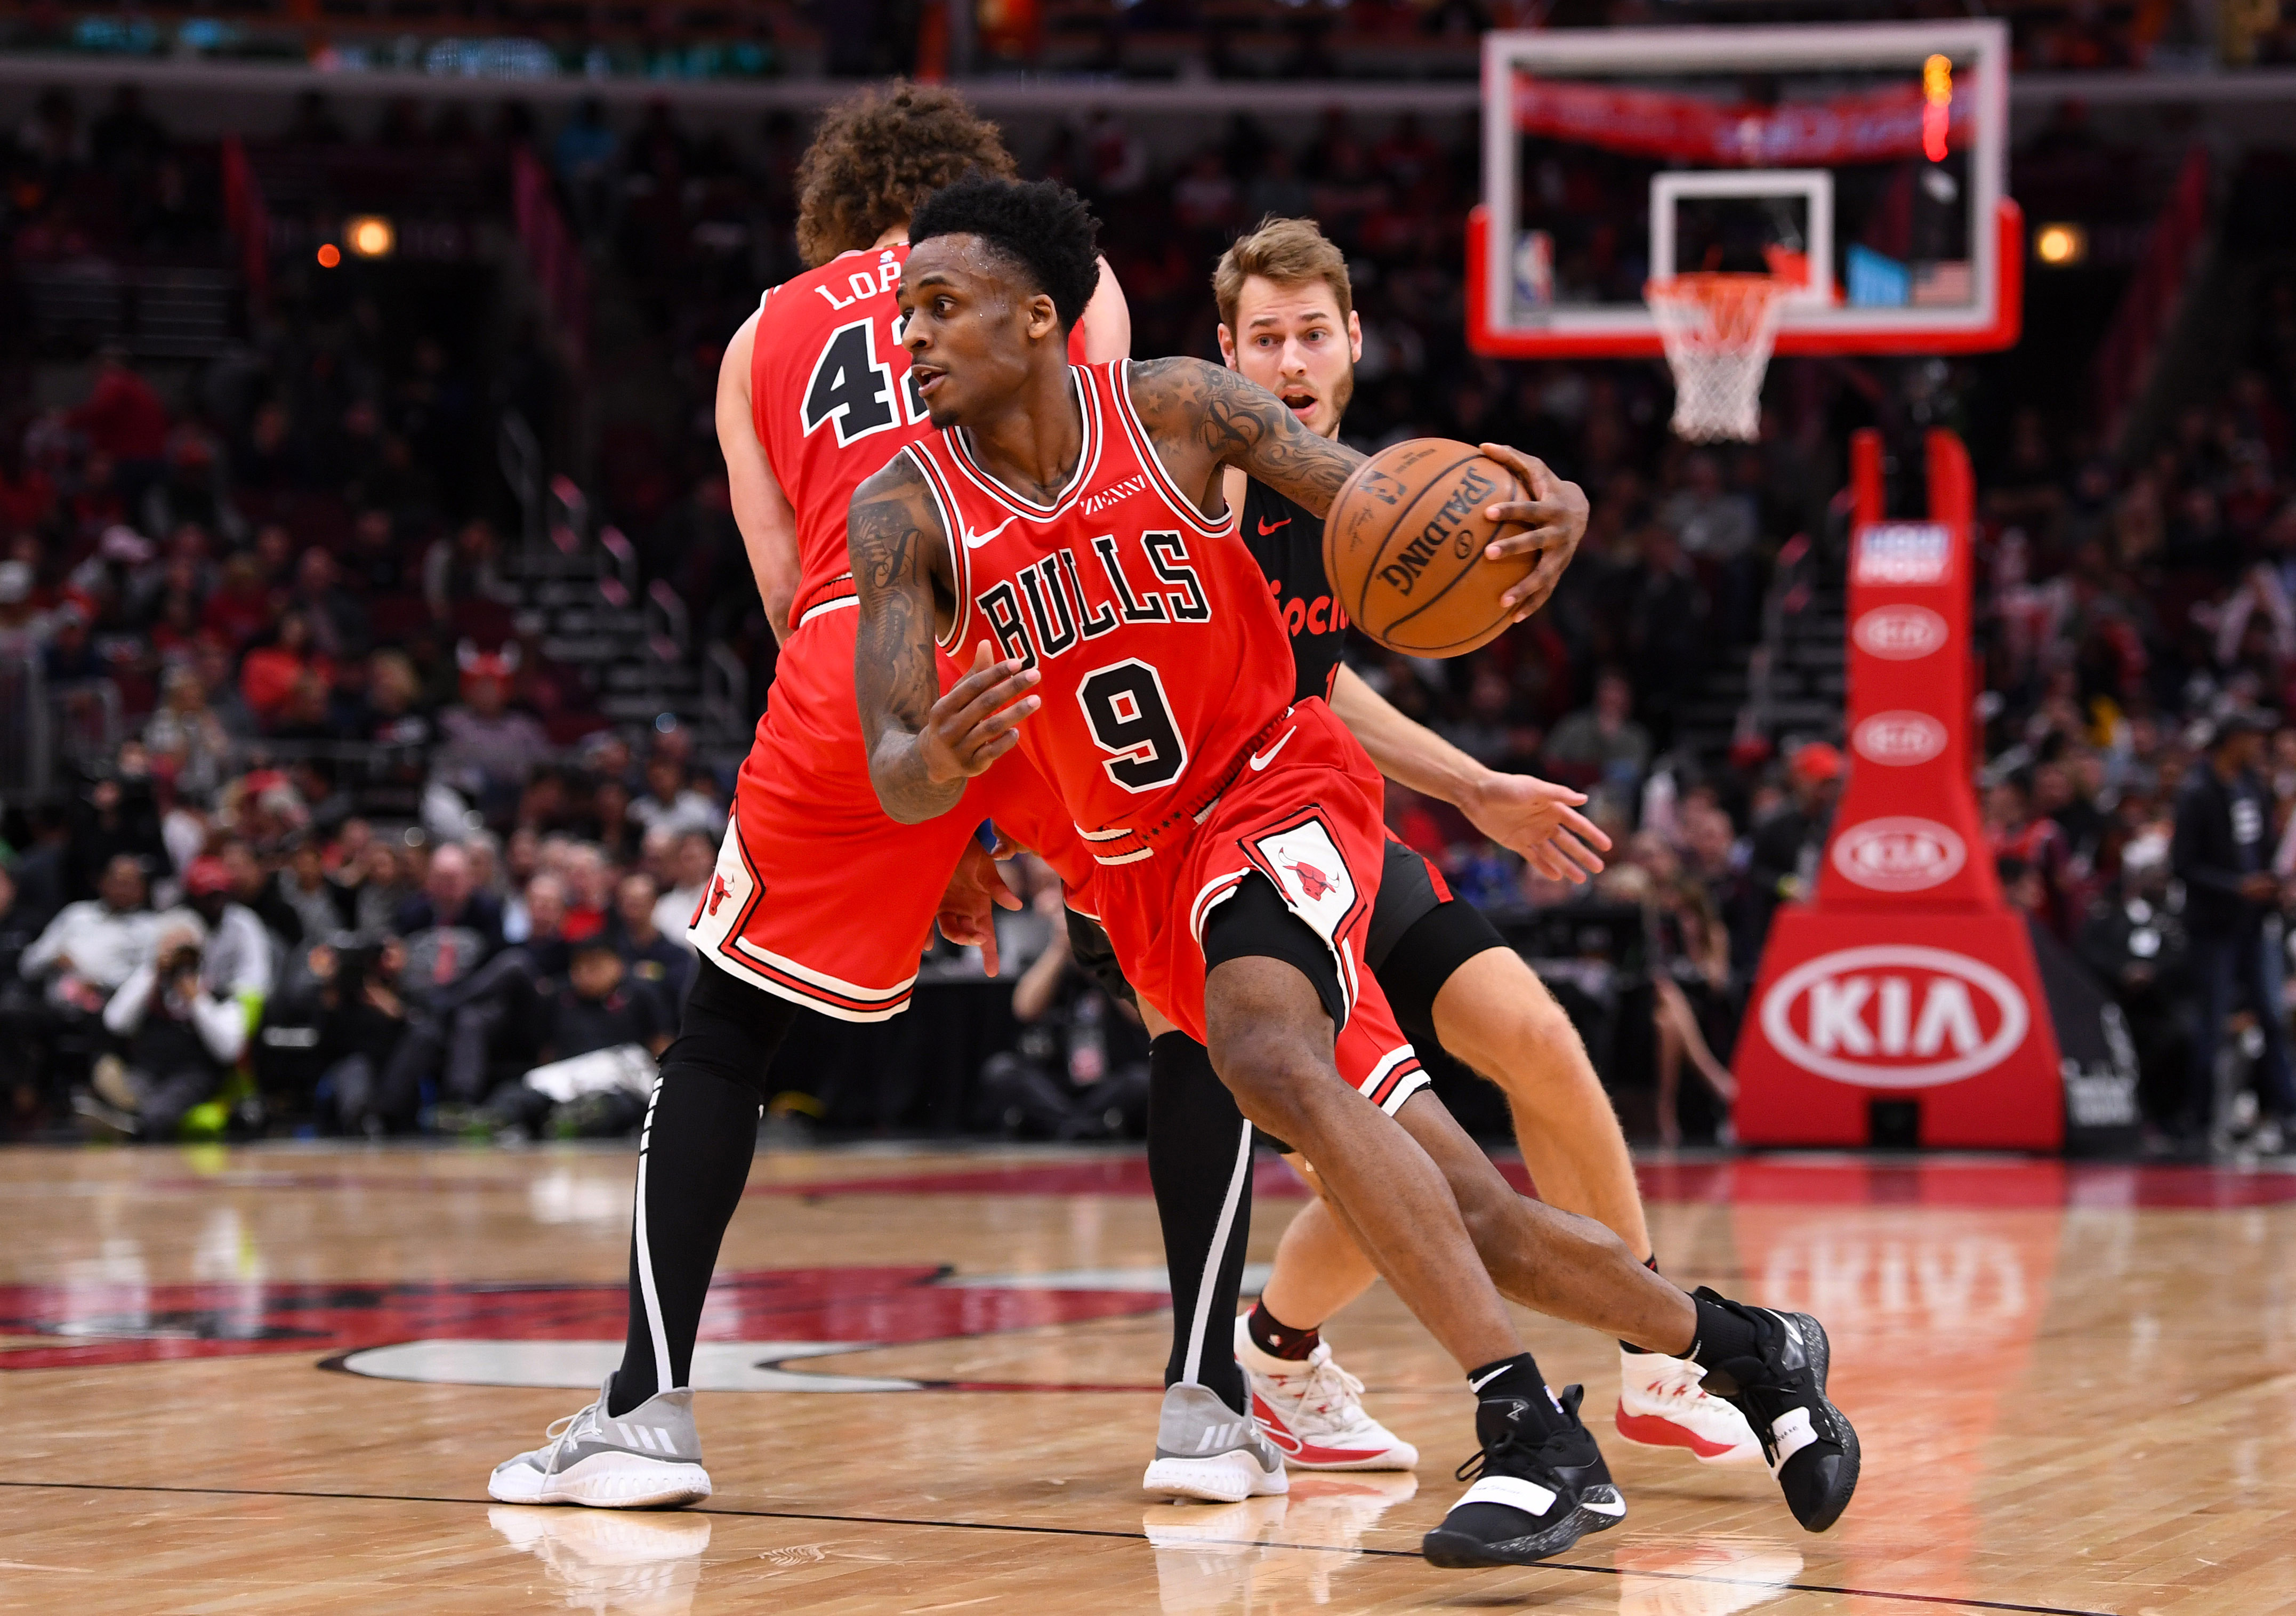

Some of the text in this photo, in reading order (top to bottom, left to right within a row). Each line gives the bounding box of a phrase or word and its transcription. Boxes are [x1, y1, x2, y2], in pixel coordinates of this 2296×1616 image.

[815, 261, 903, 311] LOP
[1079, 474, 1146, 516] ZENNI
[1376, 467, 1497, 596] SPALDING
[975, 530, 1212, 670] BULLS
[1076, 657, 1188, 794] 9
[1809, 975, 1984, 1057] KIA
